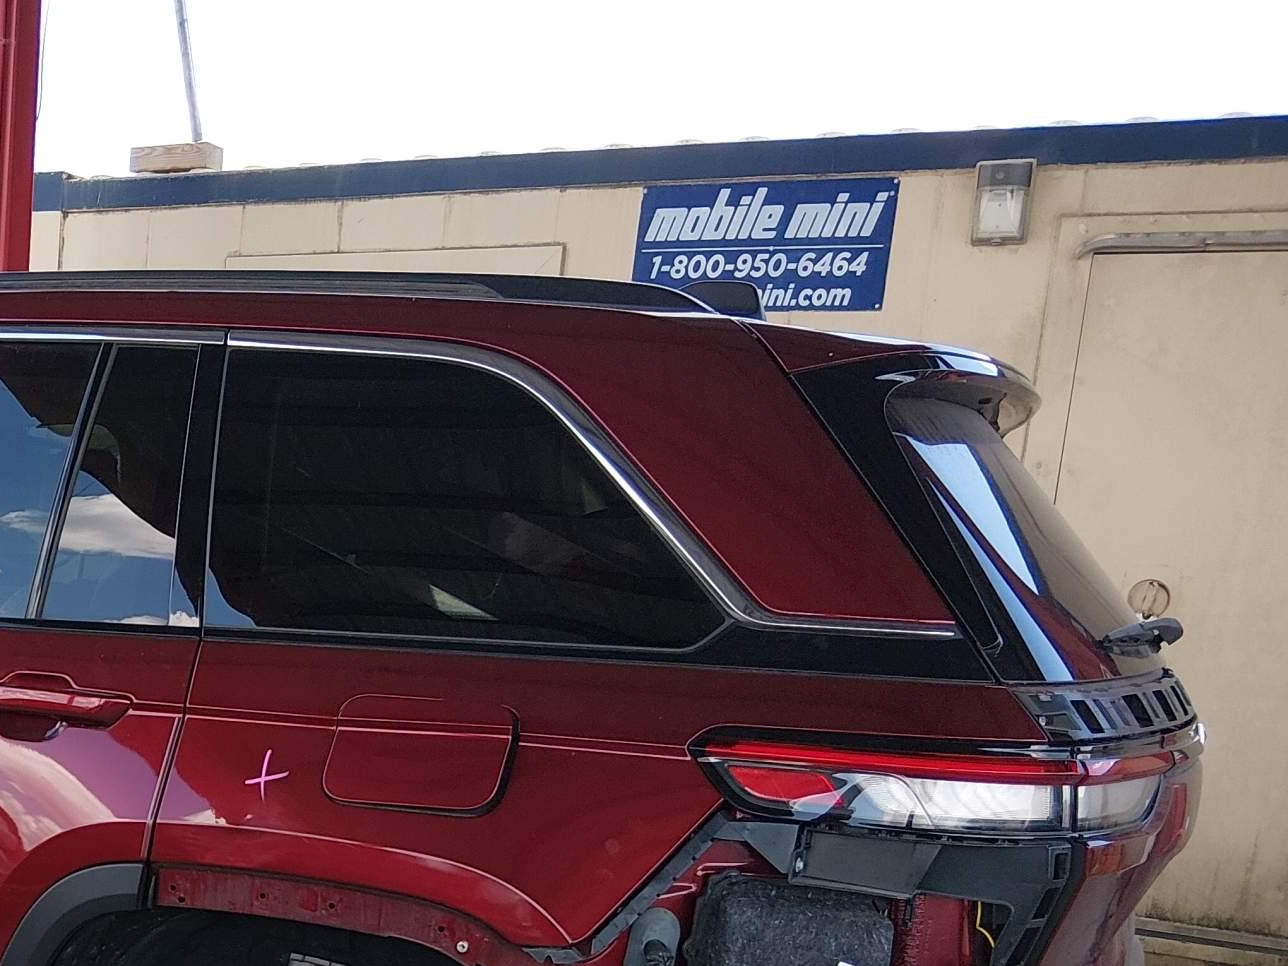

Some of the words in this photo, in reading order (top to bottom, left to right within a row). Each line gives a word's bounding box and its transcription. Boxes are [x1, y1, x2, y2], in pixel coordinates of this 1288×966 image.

[644, 187, 784, 242] mobile
[784, 192, 888, 239] mini
[650, 252, 867, 280] 1-800-950-6464
